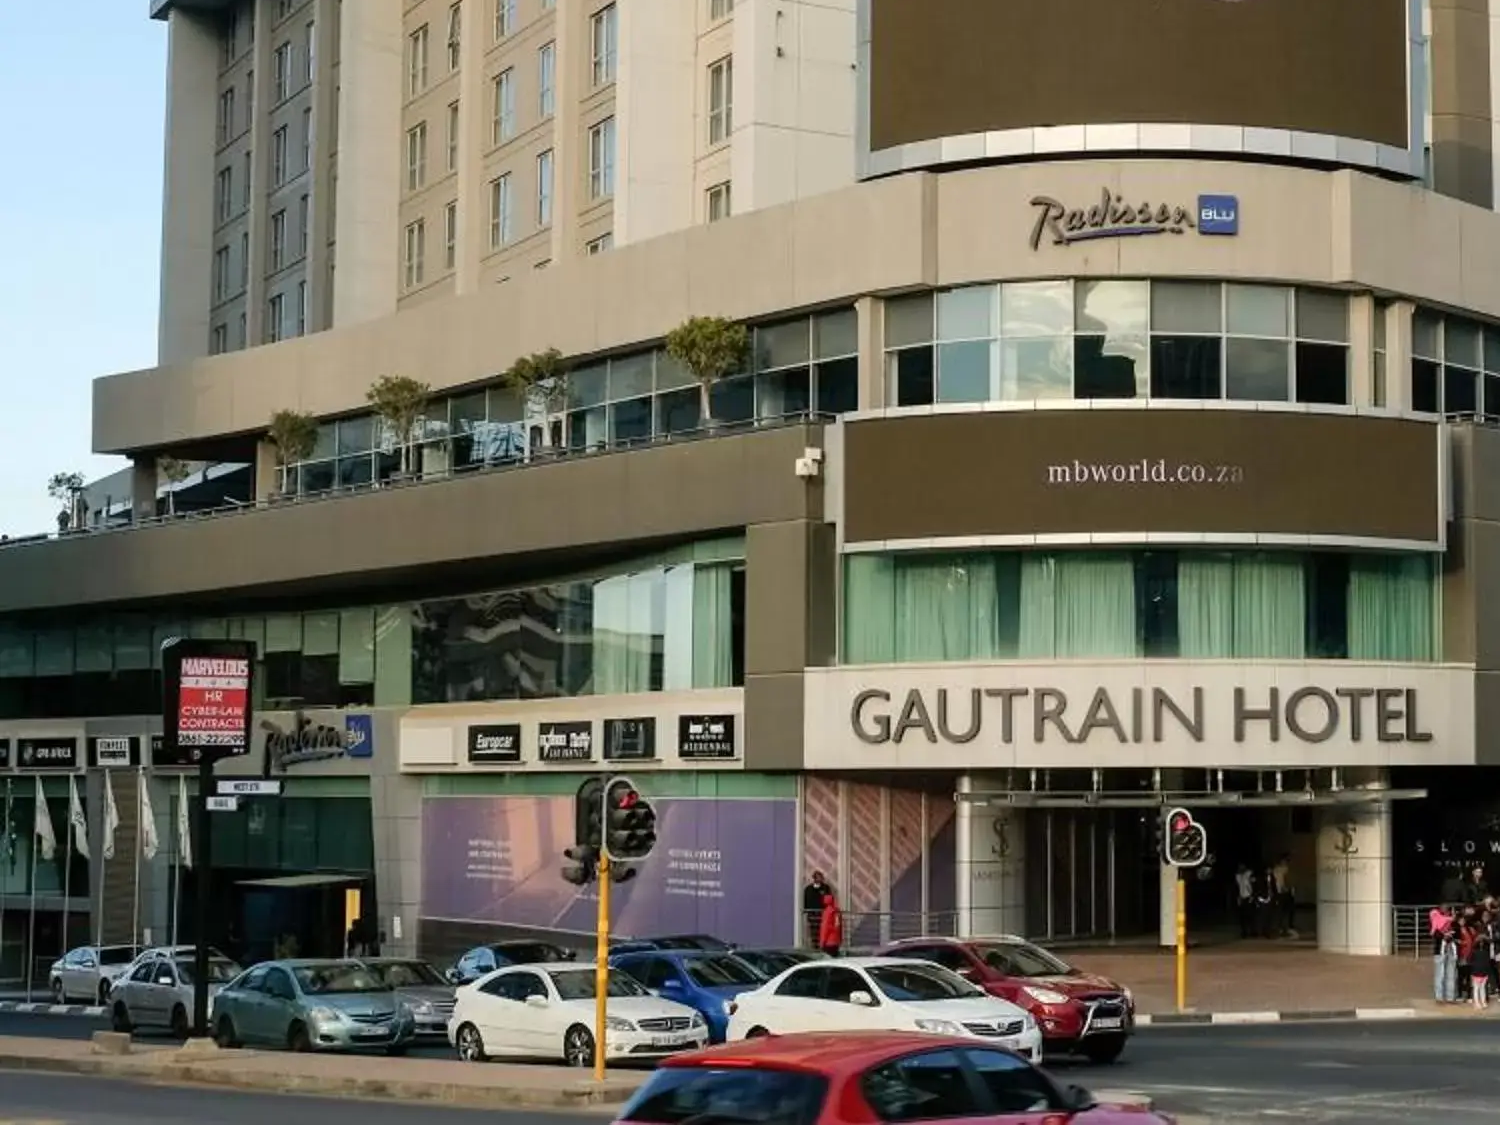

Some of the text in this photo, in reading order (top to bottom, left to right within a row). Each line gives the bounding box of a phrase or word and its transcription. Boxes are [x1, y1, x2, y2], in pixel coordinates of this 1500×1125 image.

[1029, 186, 1235, 252] Radisson BLU
[204, 690, 224, 702] HR
[851, 686, 1433, 745] GAUTRAIN HOTEL
